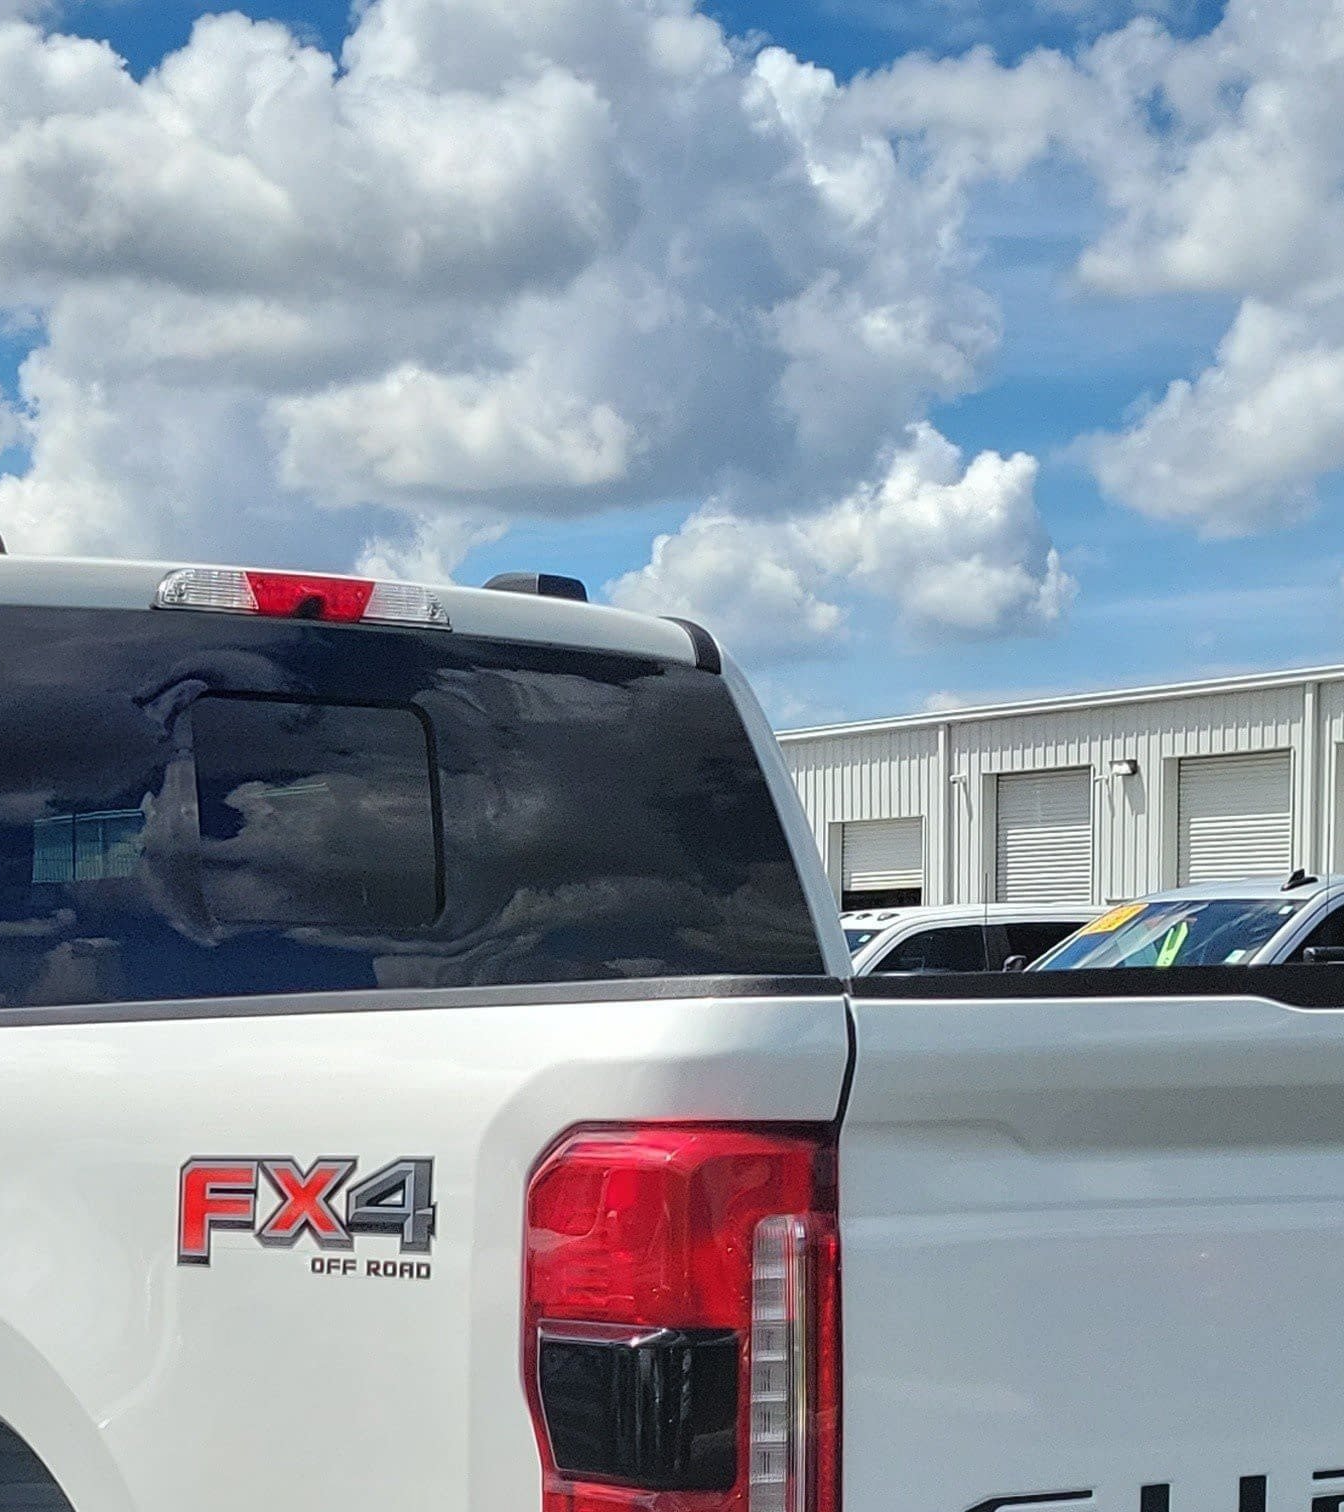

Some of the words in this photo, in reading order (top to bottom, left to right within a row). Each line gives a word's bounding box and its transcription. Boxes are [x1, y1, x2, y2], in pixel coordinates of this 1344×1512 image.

[177, 1154, 437, 1267] FX4
[310, 1256, 357, 1276] OFF
[365, 1259, 431, 1280] ROAD
